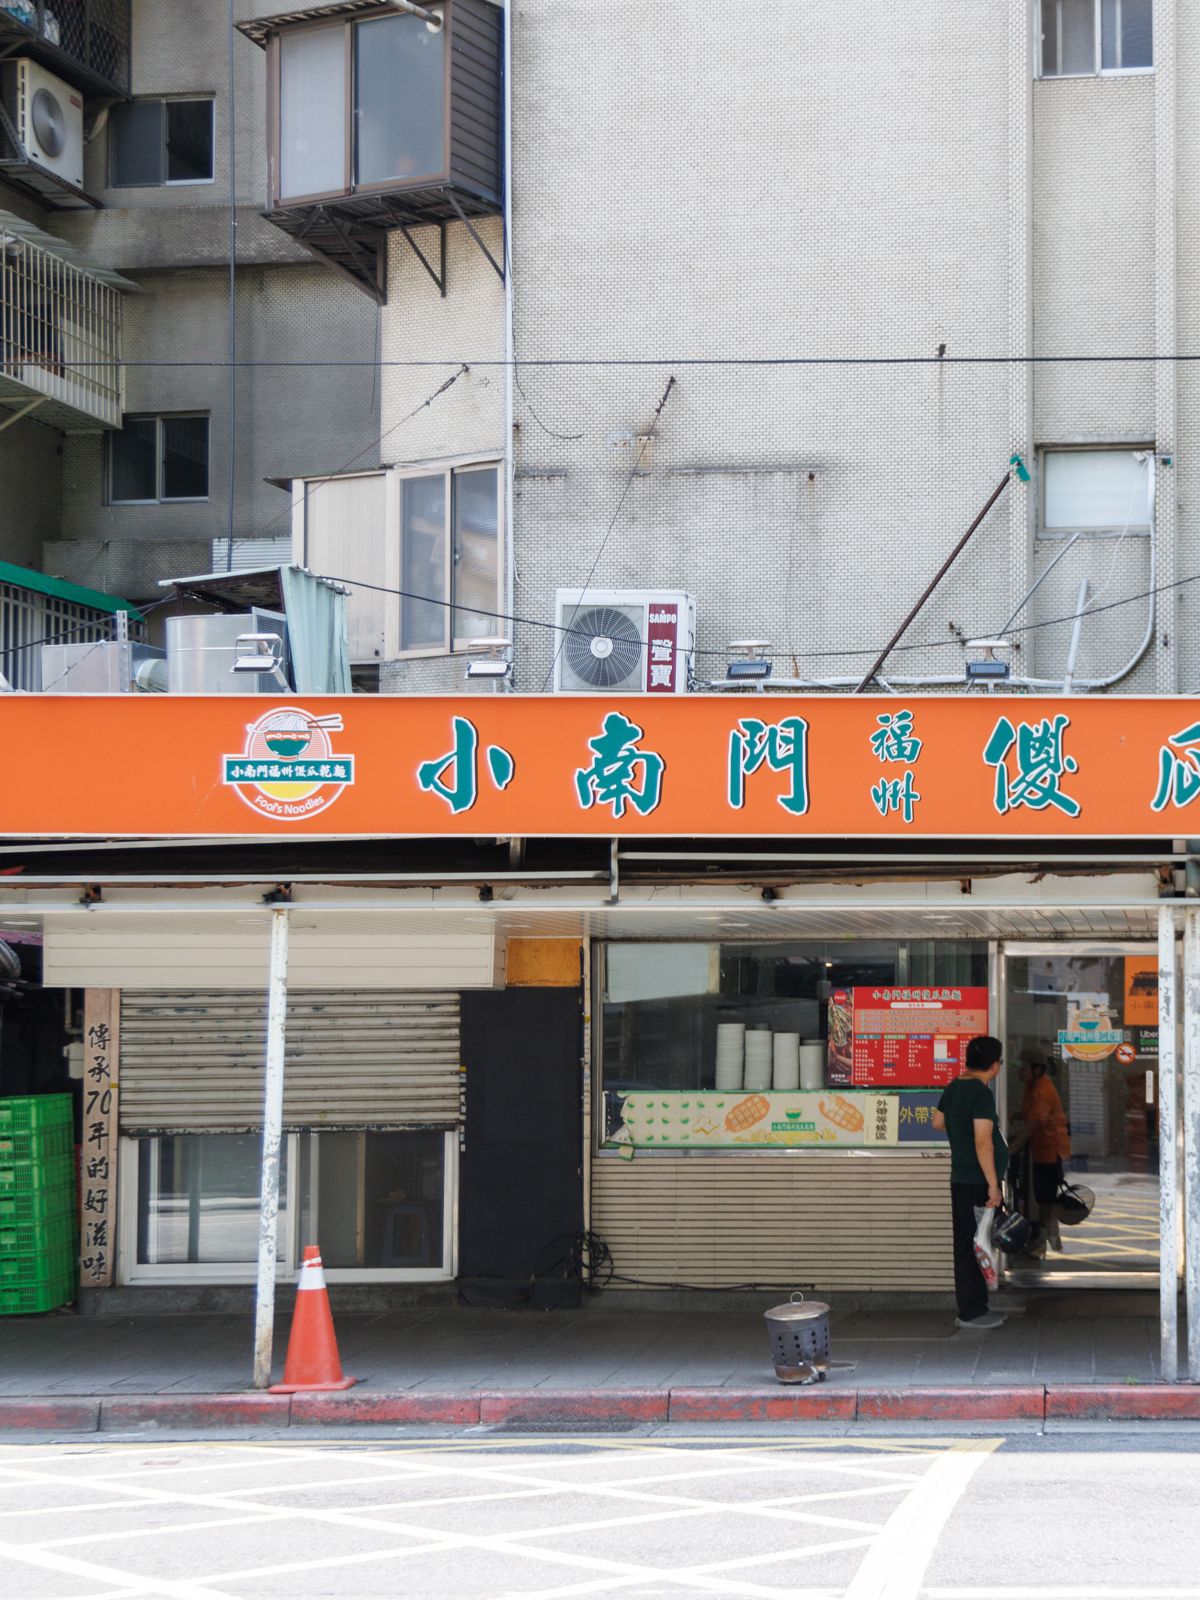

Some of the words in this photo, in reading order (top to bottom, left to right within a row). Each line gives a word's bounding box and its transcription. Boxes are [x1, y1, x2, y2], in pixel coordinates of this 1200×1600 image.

[649, 609, 677, 624] SAMPO
[650, 638, 673, 688] 聲寶
[230, 764, 347, 779] 小南門福州傻瓜乾麵
[254, 795, 283, 814] Fool's
[285, 796, 325, 815] Noodles
[875, 1099, 889, 1141] 外帶等候區
[82, 1023, 113, 1281] 傳承70年的好滋味
